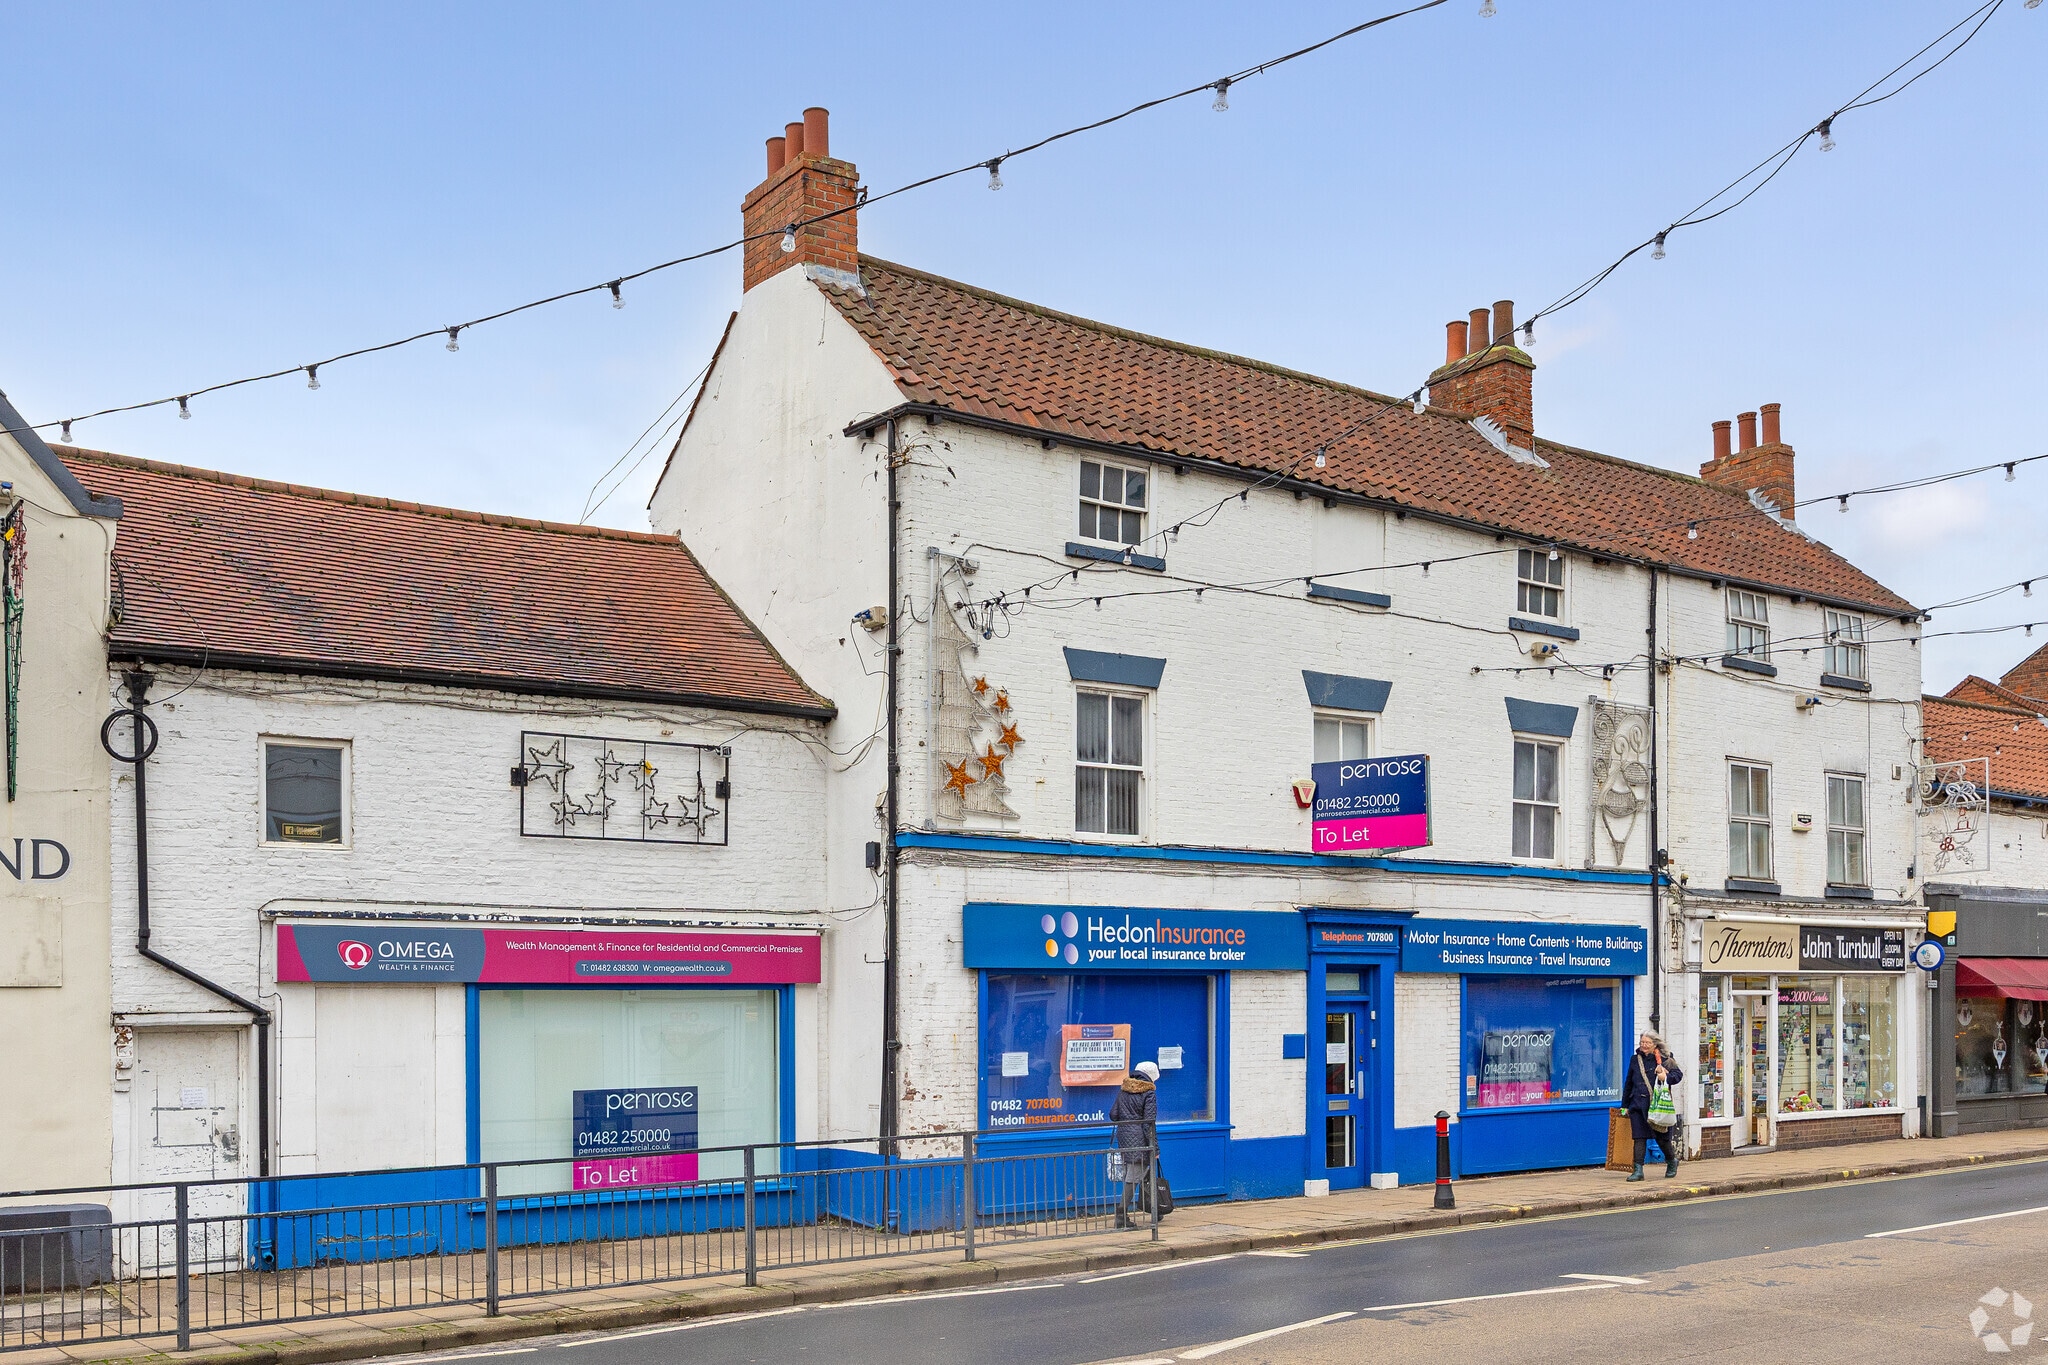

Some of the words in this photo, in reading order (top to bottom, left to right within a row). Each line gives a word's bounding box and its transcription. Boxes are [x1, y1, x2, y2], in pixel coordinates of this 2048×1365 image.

[1340, 759, 1421, 787] penrose
[1316, 797, 1351, 810] 01482
[1354, 793, 1400, 807] 250000
[1316, 806, 1400, 819] penrosecommercial.co.uk
[1316, 827, 1337, 843] To
[1343, 826, 1370, 842] Let
[1321, 931, 1364, 944] Telephone:
[1366, 932, 1394, 942] 707800
[1408, 929, 1440, 944] Motor
[1443, 931, 1490, 946] Insurance
[1497, 933, 1526, 947] Home
[1529, 934, 1570, 948] Contents
[1576, 935, 1603, 949] Home
[1605, 936, 1643, 953] Buildings
[1709, 926, 1794, 965] Thorntons
[378, 941, 454, 958] OMEGA
[506, 941, 537, 950] Wealth
[539, 941, 596, 952] Management
[598, 943, 604, 951] &
[607, 943, 641, 952] Finance
[642, 943, 654, 951] for
[657, 943, 701, 952] Residential
[703, 944, 719, 952] and
[721, 944, 767, 953] Commercial
[769, 945, 803, 953] Premises
[1088, 948, 1117, 962] your
[1120, 947, 1148, 960] local
[1152, 947, 1206, 960] insurance
[1209, 948, 1246, 961] broker
[1802, 934, 1832, 959] John
[1835, 935, 1881, 959] Turnbull
[1442, 950, 1484, 964] Business
[1488, 951, 1533, 965] Insurance
[1539, 952, 1565, 966] Travel
[1569, 953, 1611, 967] Insurance
[378, 963, 410, 971] WEALTH
[421, 964, 455, 972] FINANCE
[582, 964, 589, 972] T:
[590, 964, 611, 972] 01482
[613, 964, 639, 972] 638300
[643, 964, 652, 972] W:
[653, 964, 726, 973] omegawealth.co.uk
[1502, 1033, 1552, 1053] penrose
[1482, 1090, 1495, 1104] To
[1498, 1090, 1516, 1104] Let
[1544, 1089, 1561, 1099] local
[1563, 1088, 1595, 1098] insurance
[1596, 1087, 1619, 1096] broker
[606, 1091, 694, 1118] penrose
[990, 1099, 1022, 1111] 01482
[1025, 1097, 1063, 1110] 707800
[990, 1109, 1105, 1126] hedoninsurance.co.uk
[579, 1130, 618, 1146] 01482
[621, 1128, 671, 1143] 250000
[578, 1143, 671, 1155] penrosecommercial.co.uk
[579, 1166, 602, 1185] To
[609, 1165, 638, 1183] Let
